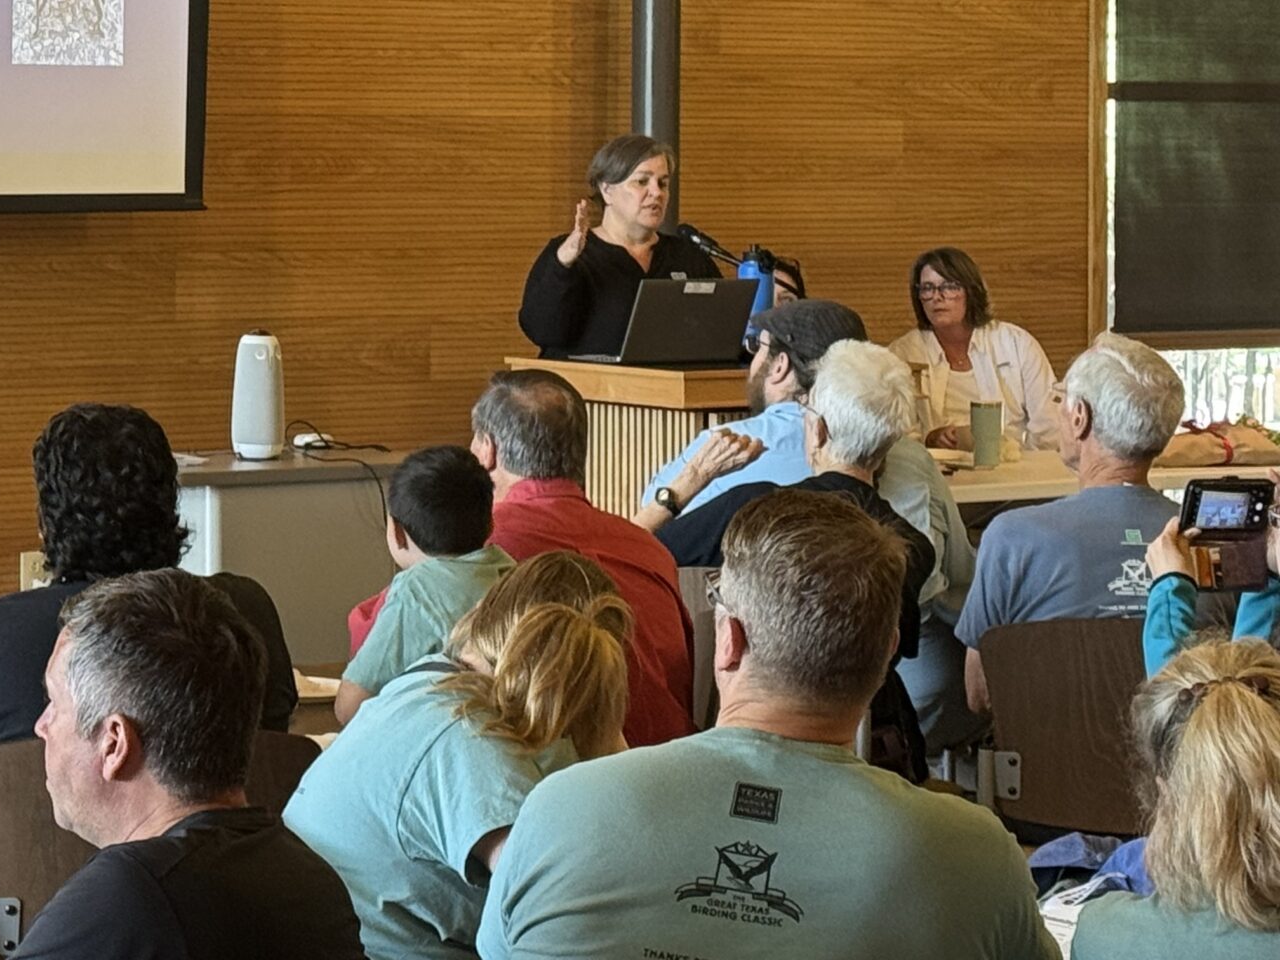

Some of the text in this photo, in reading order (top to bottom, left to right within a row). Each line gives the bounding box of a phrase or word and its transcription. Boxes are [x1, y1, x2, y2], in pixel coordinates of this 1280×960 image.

[691, 904, 784, 928] BIRDING CLASSIC
[706, 898, 770, 916] GREAT TEXAS
